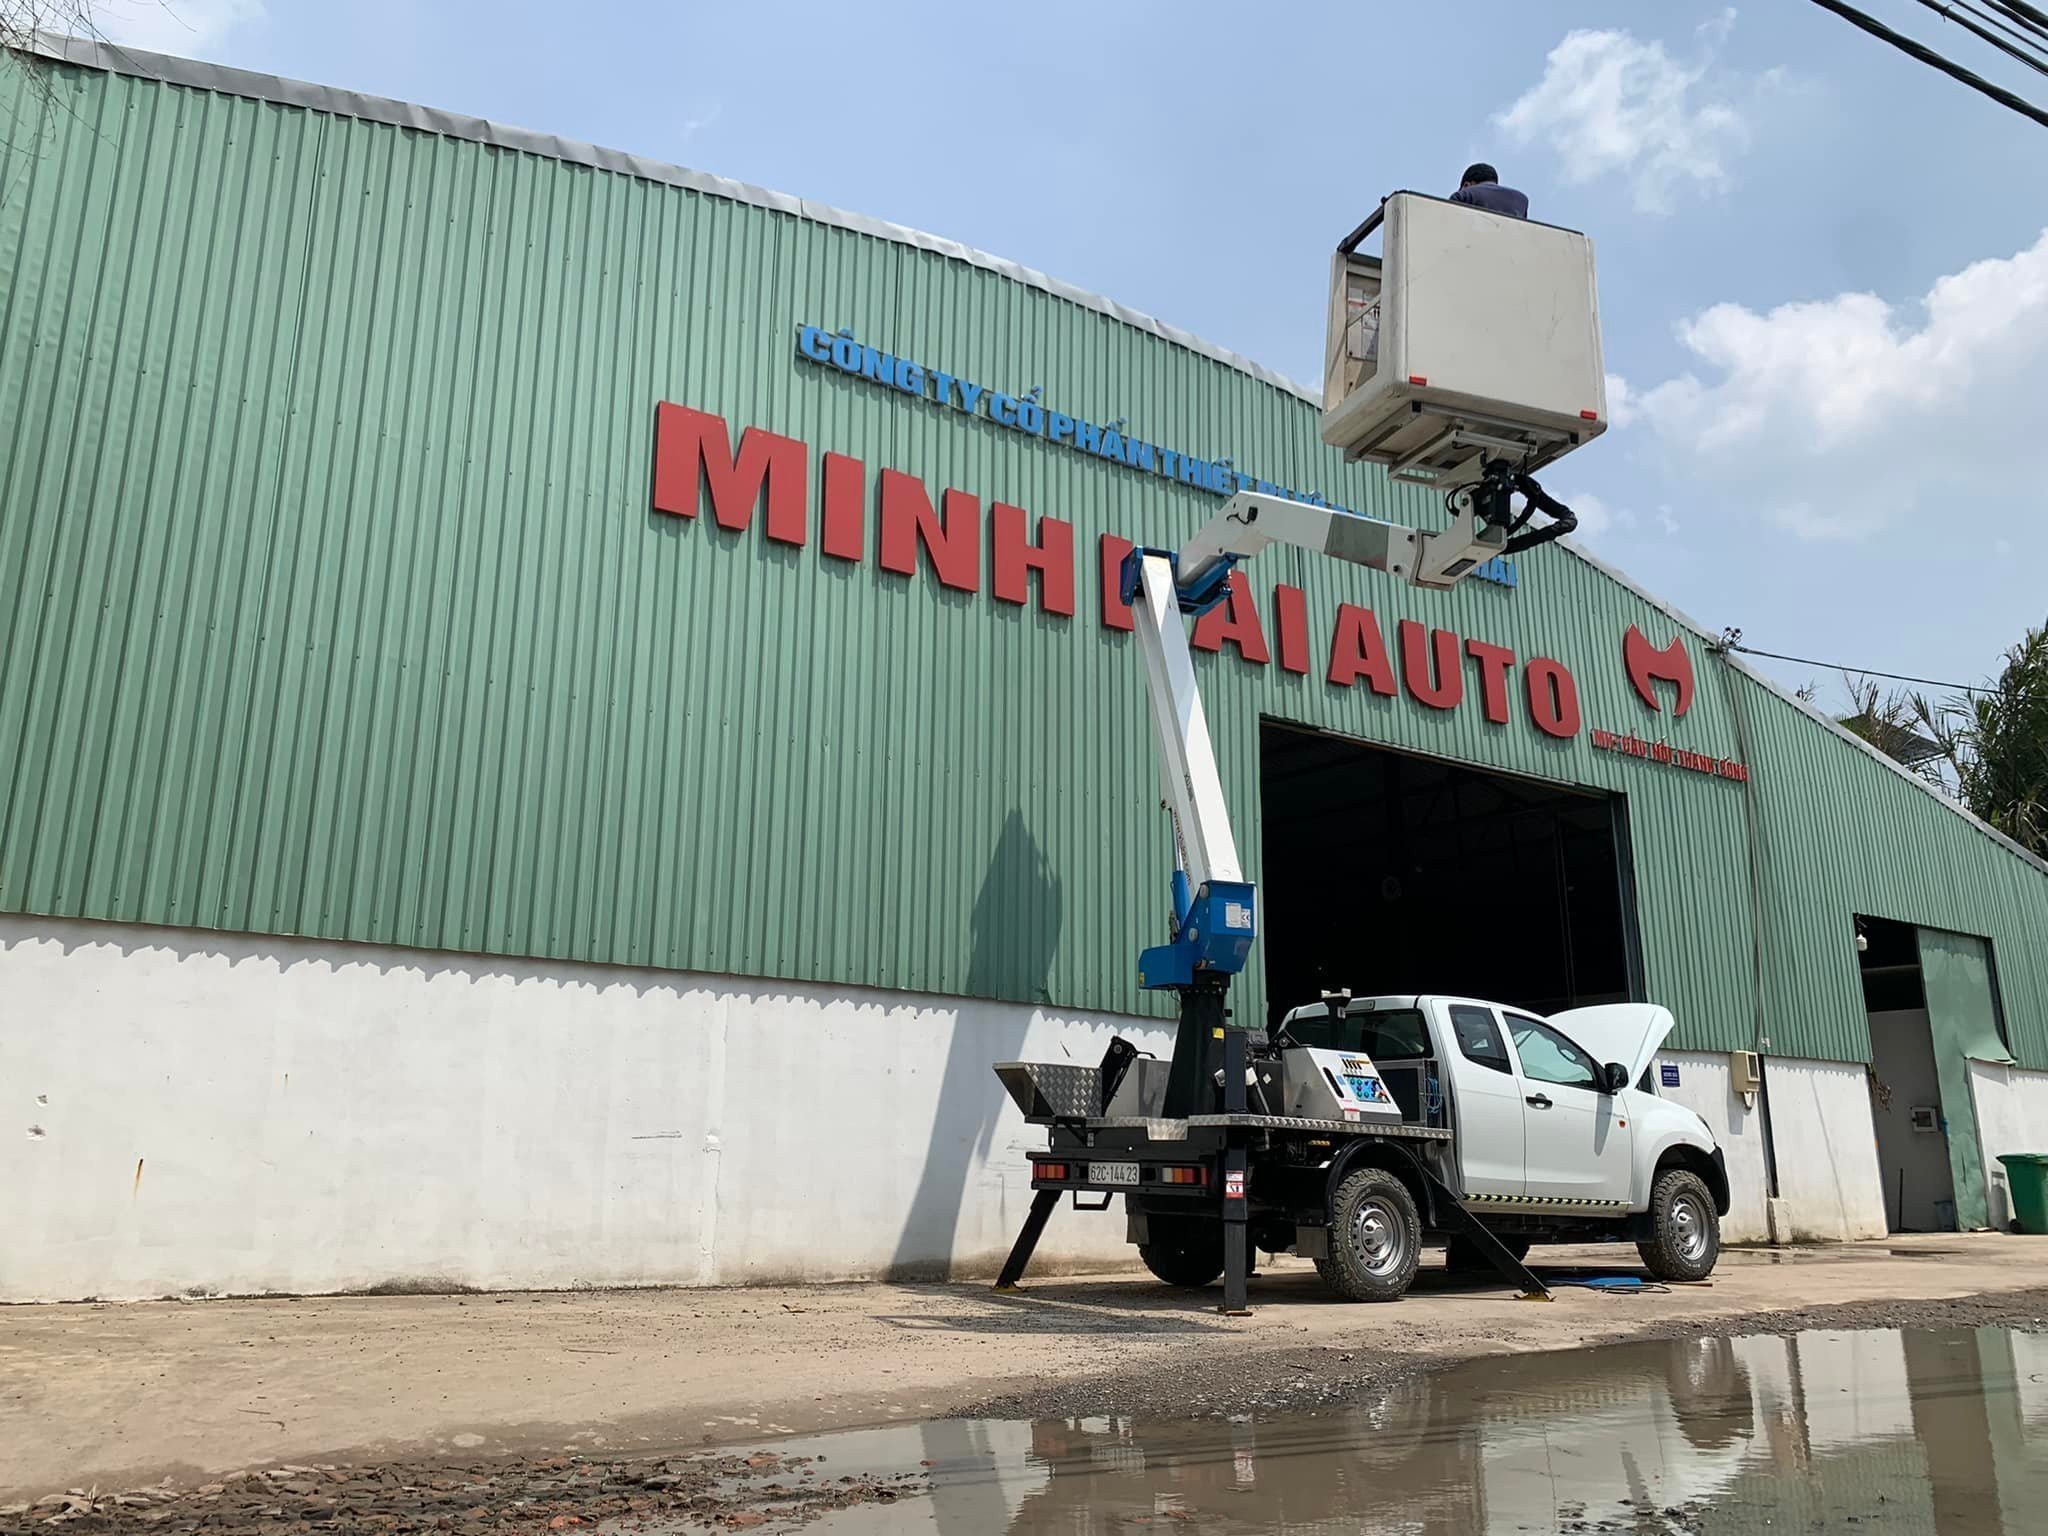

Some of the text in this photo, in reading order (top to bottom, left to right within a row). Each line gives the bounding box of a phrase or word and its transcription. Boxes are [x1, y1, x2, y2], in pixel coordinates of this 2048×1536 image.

[799, 326, 925, 397] CÔNG
[931, 370, 984, 413] TY
[989, 385, 1044, 437] CỔ
[653, 400, 1076, 617] MINH
[1327, 603, 1581, 738] AUTO
